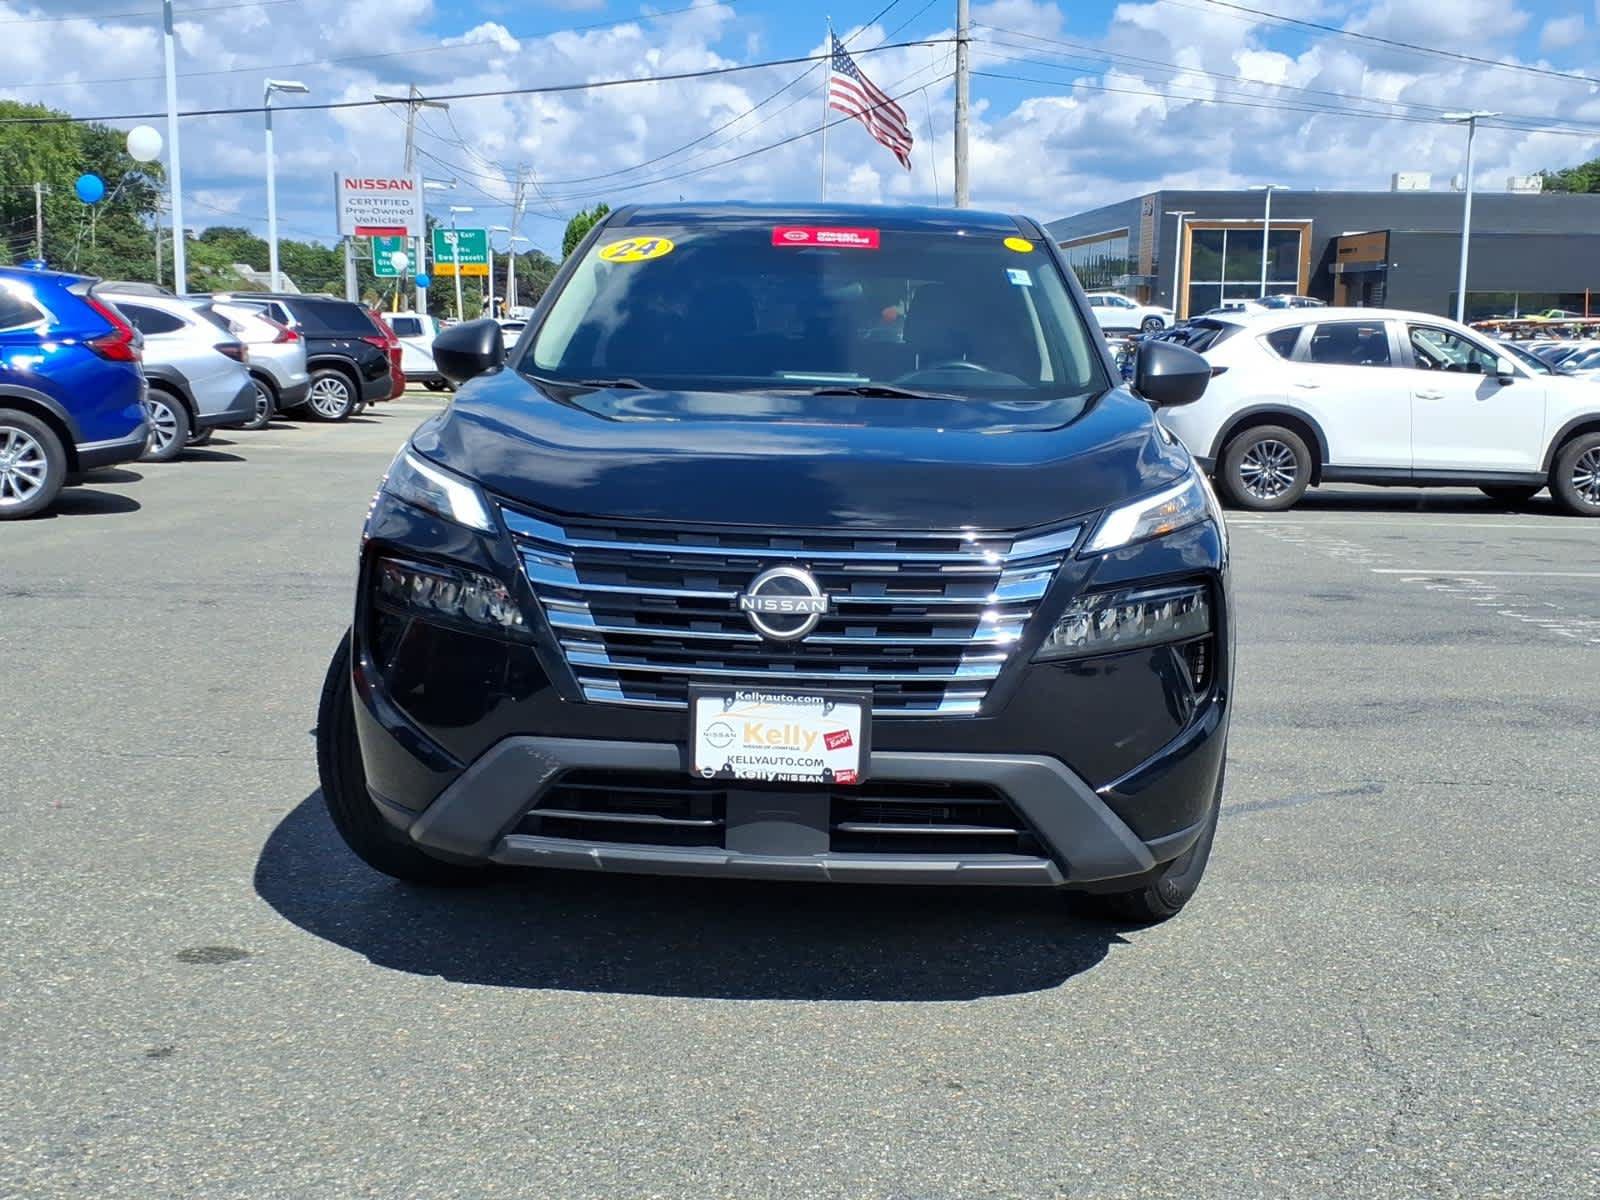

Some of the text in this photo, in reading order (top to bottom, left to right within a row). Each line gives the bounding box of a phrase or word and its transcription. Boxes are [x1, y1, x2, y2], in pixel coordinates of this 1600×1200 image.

[345, 179, 413, 190] NISSAN
[348, 198, 410, 206] CERTIFIED
[345, 207, 414, 216] Pre-Owned
[354, 216, 405, 224] Vehicles
[613, 240, 659, 258] 24
[741, 598, 826, 612] NISSAN
[735, 690, 824, 704] Kellyauto.com
[742, 721, 819, 752] Kelly
[727, 755, 825, 767] KELLYAUTO.COM
[735, 767, 778, 781] Kelly
[778, 773, 824, 783] NISSAN
